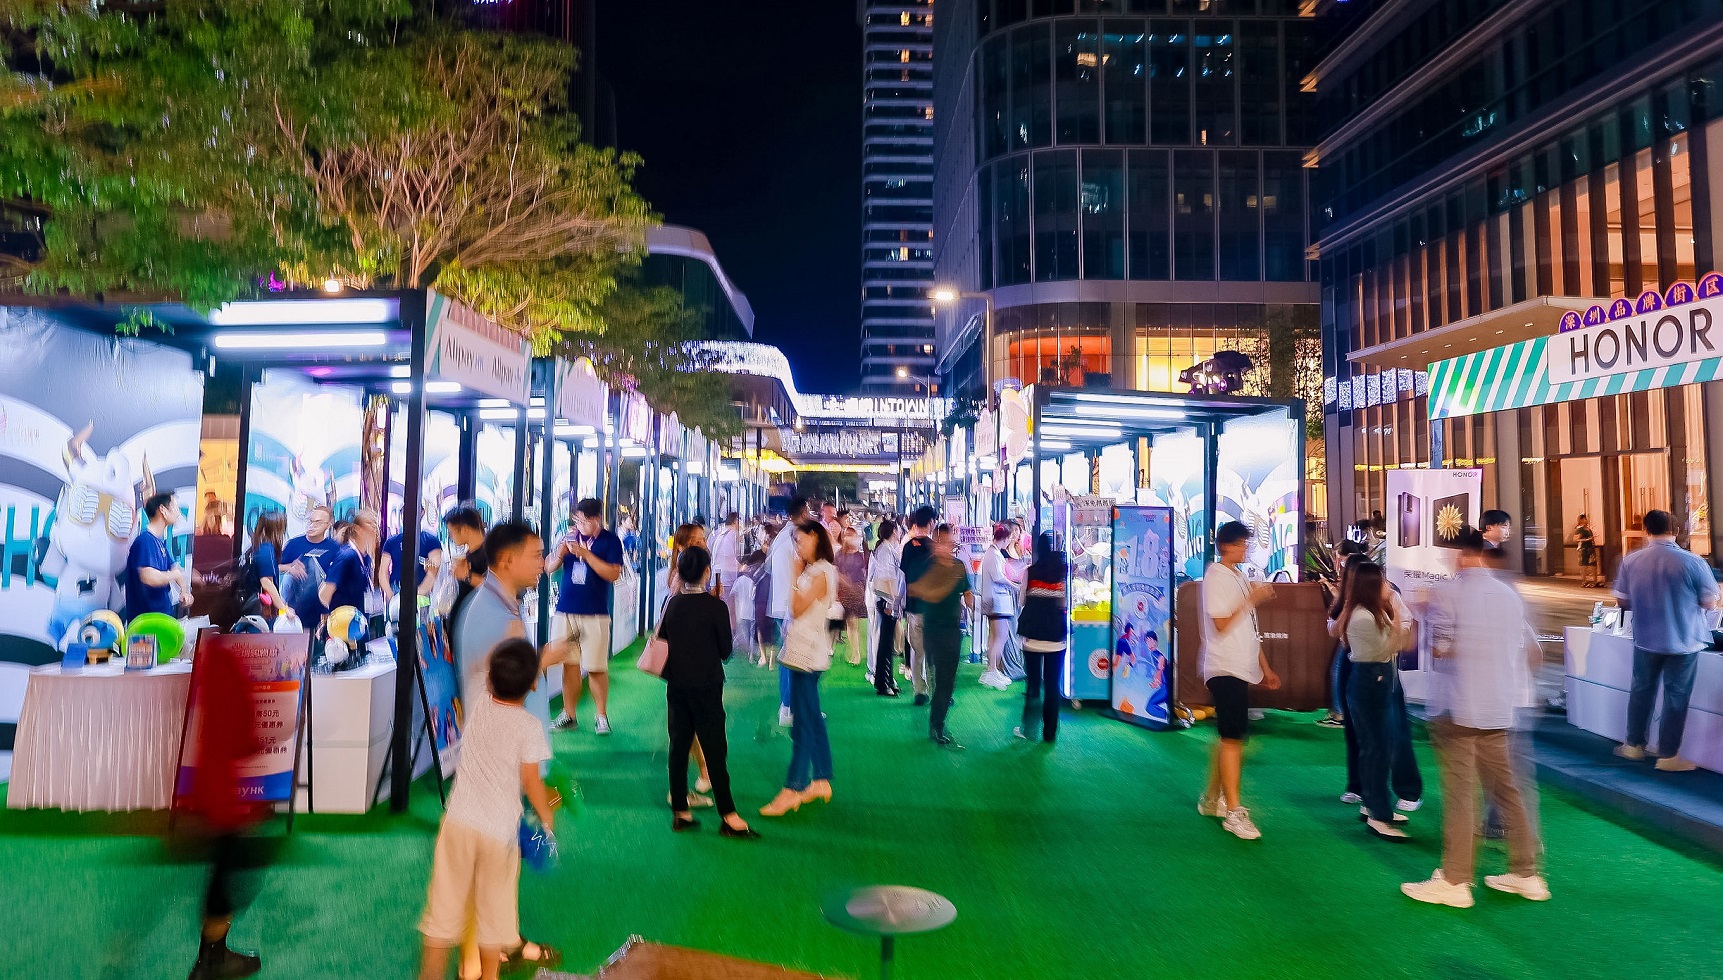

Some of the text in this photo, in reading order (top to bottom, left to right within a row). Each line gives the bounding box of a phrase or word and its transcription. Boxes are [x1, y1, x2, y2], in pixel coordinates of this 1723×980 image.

[1564, 276, 1720, 329] 深圳品牌街区
[1569, 307, 1716, 375] HONOR
